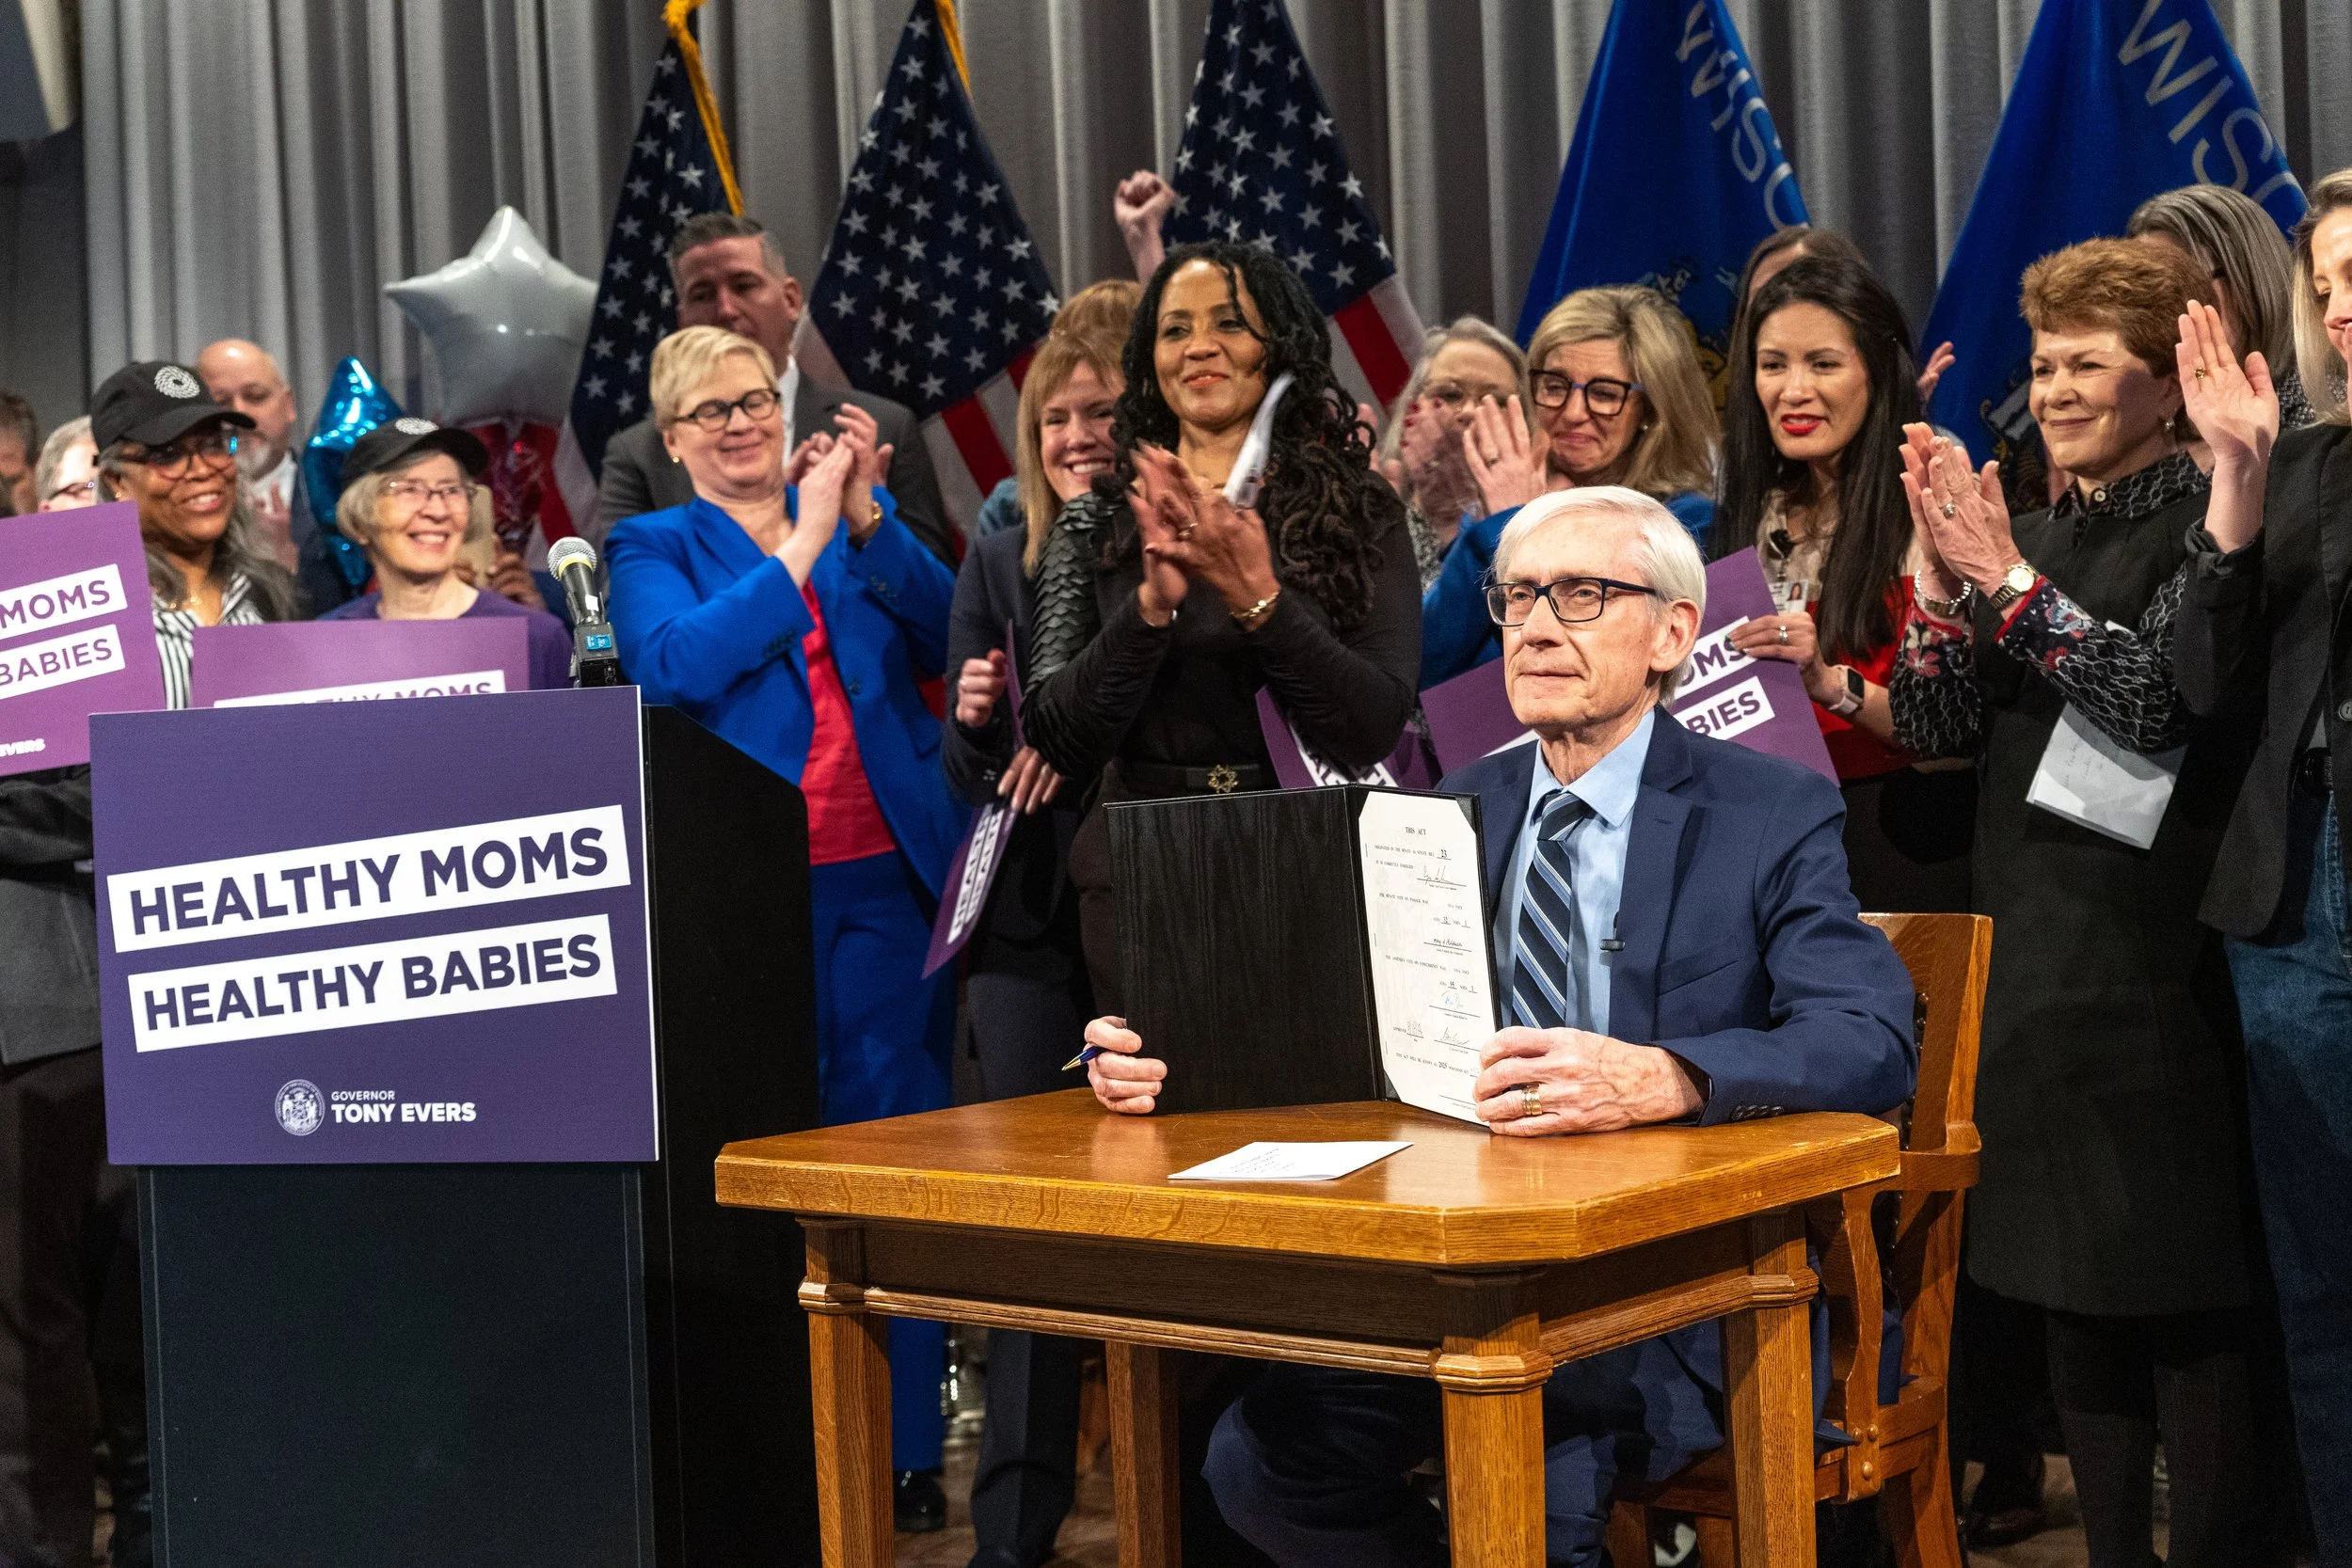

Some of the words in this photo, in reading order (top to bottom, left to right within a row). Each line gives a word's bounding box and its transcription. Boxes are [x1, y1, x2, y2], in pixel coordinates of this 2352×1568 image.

[130, 854, 401, 936] HEALTHY
[421, 827, 609, 897] MOMS
[144, 960, 385, 1031] HEALTHY
[402, 934, 602, 1000] BABIES
[331, 1090, 395, 1101] GOVERNOR
[331, 1103, 396, 1123] TONY
[401, 1101, 477, 1123] EVERS
